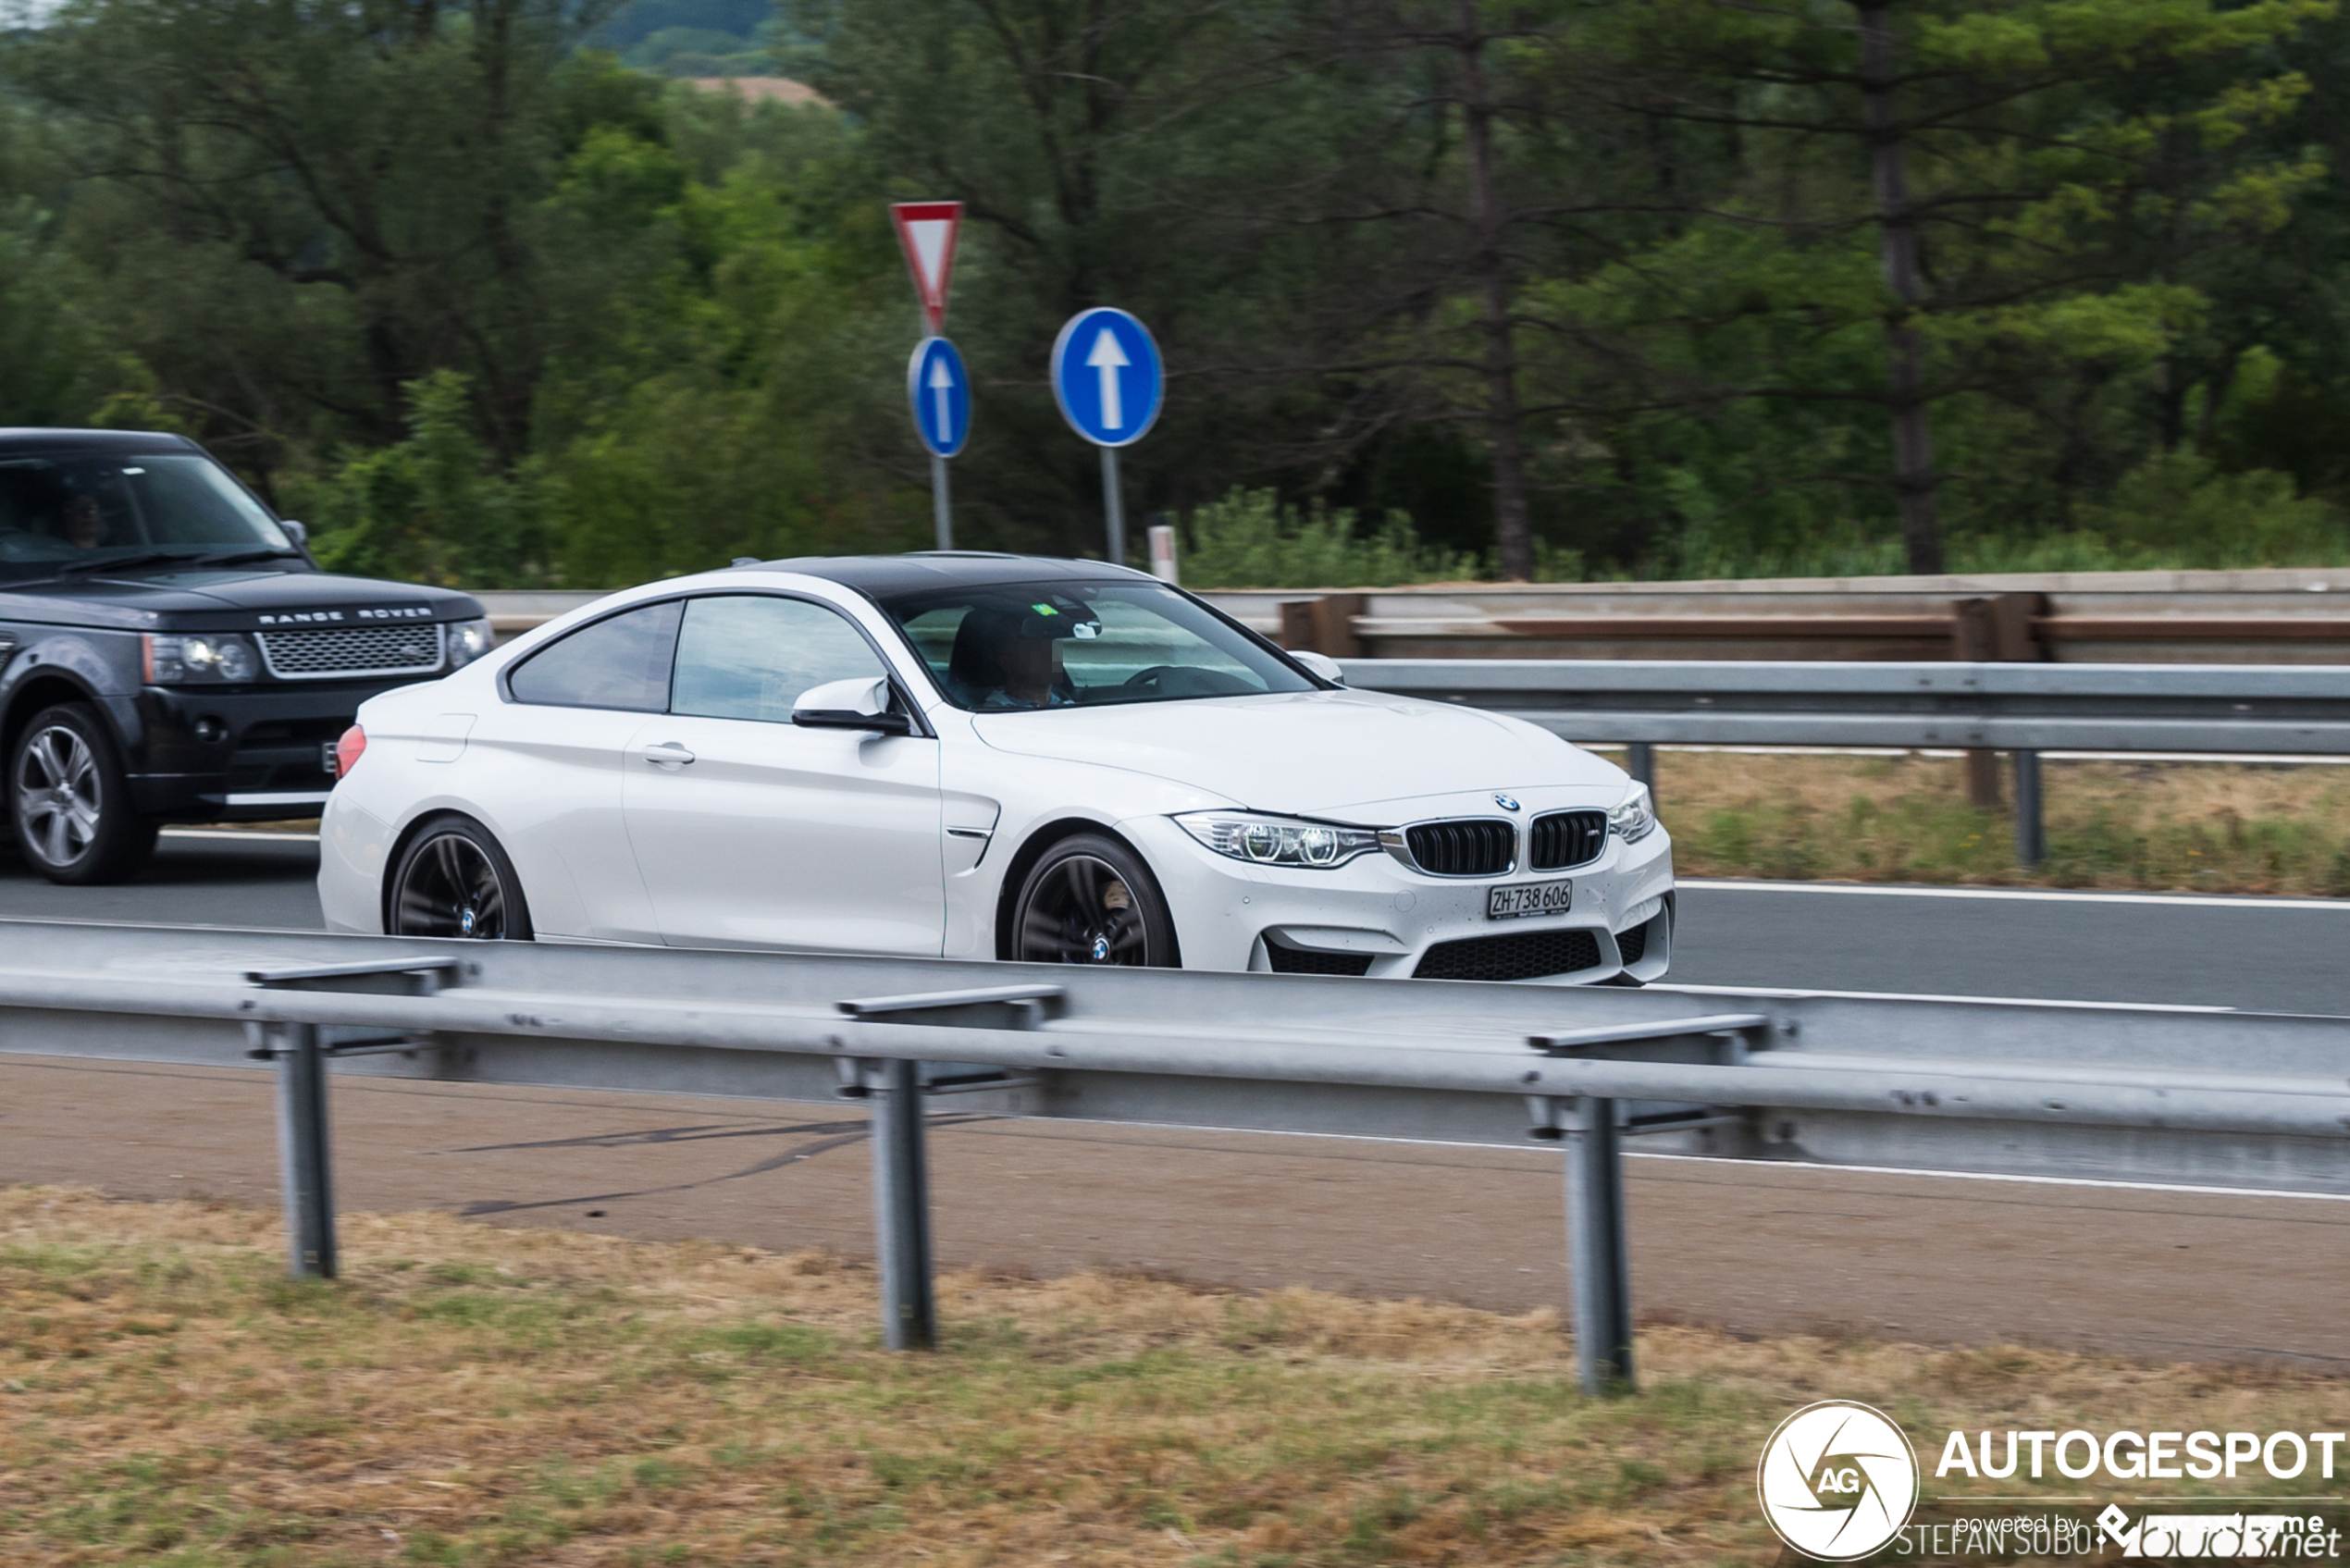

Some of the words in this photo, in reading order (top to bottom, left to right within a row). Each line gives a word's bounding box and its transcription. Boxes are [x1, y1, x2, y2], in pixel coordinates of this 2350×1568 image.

[258, 611, 344, 624] RANGE
[357, 607, 433, 619] ROVER
[1542, 883, 1569, 907] 606
